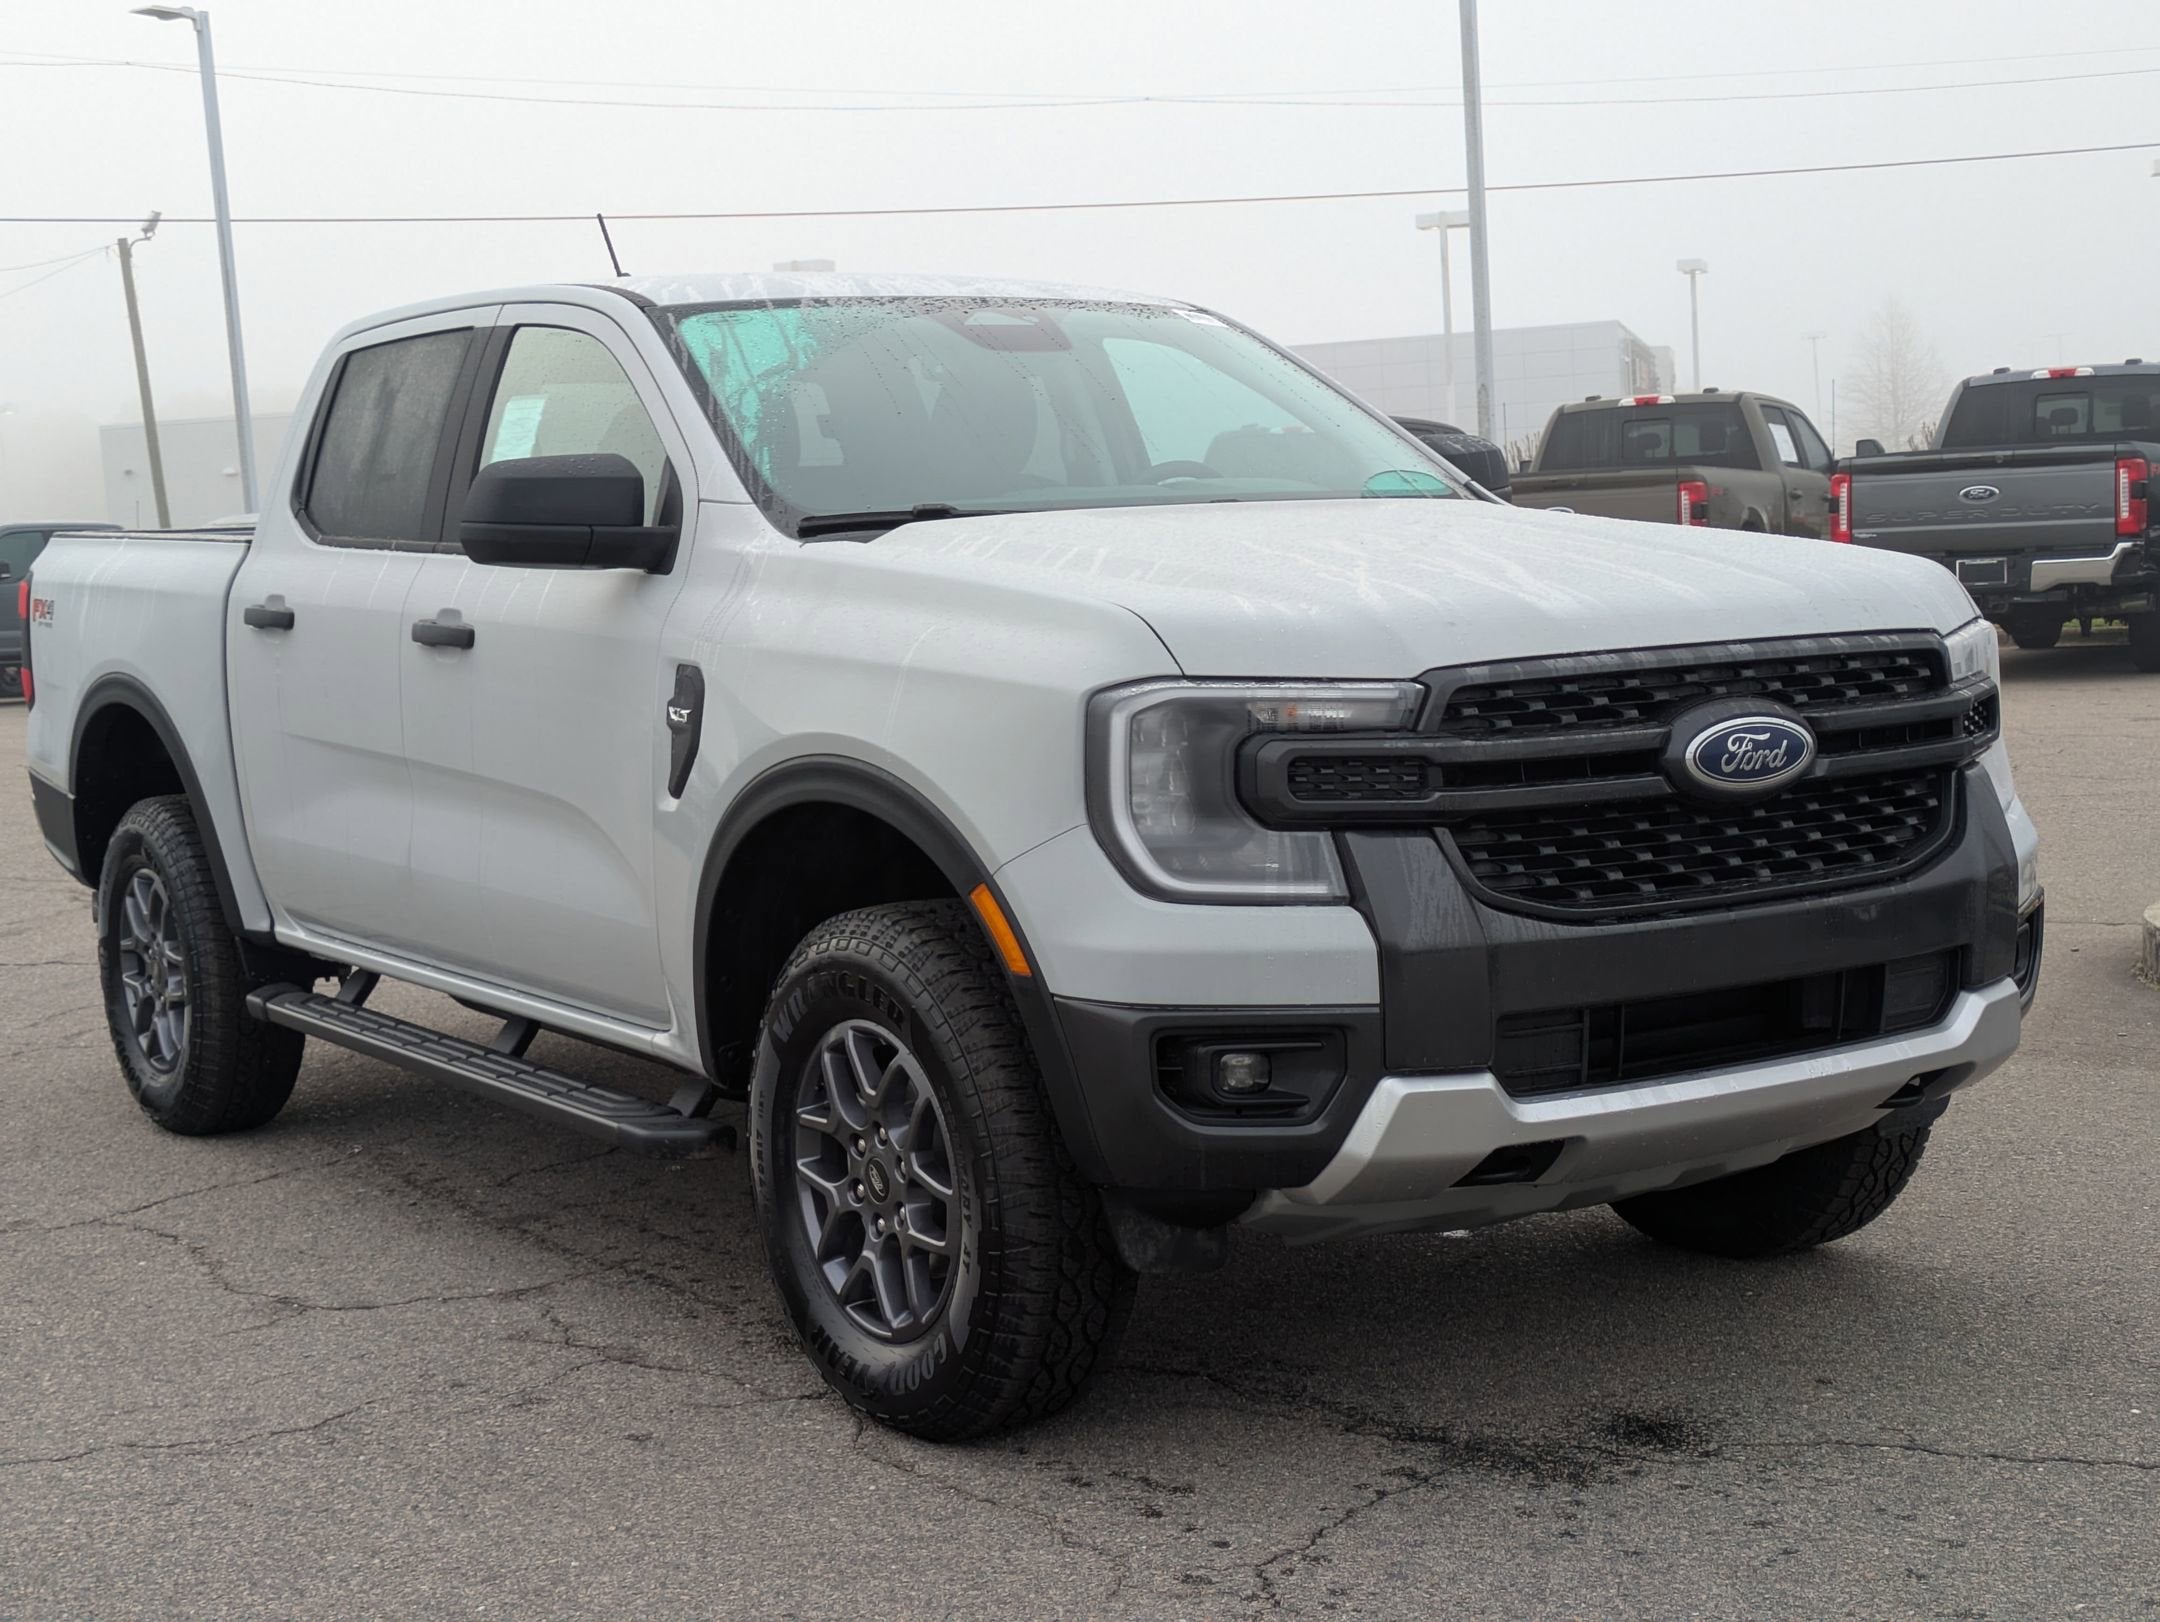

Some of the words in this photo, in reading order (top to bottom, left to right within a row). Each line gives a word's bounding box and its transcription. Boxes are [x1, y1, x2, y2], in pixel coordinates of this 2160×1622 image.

[1865, 509, 1989, 523] SUPER
[2000, 503, 2099, 517] DUTY
[1721, 732, 1787, 773] Ford
[810, 1325, 947, 1399] GOODYEAR
